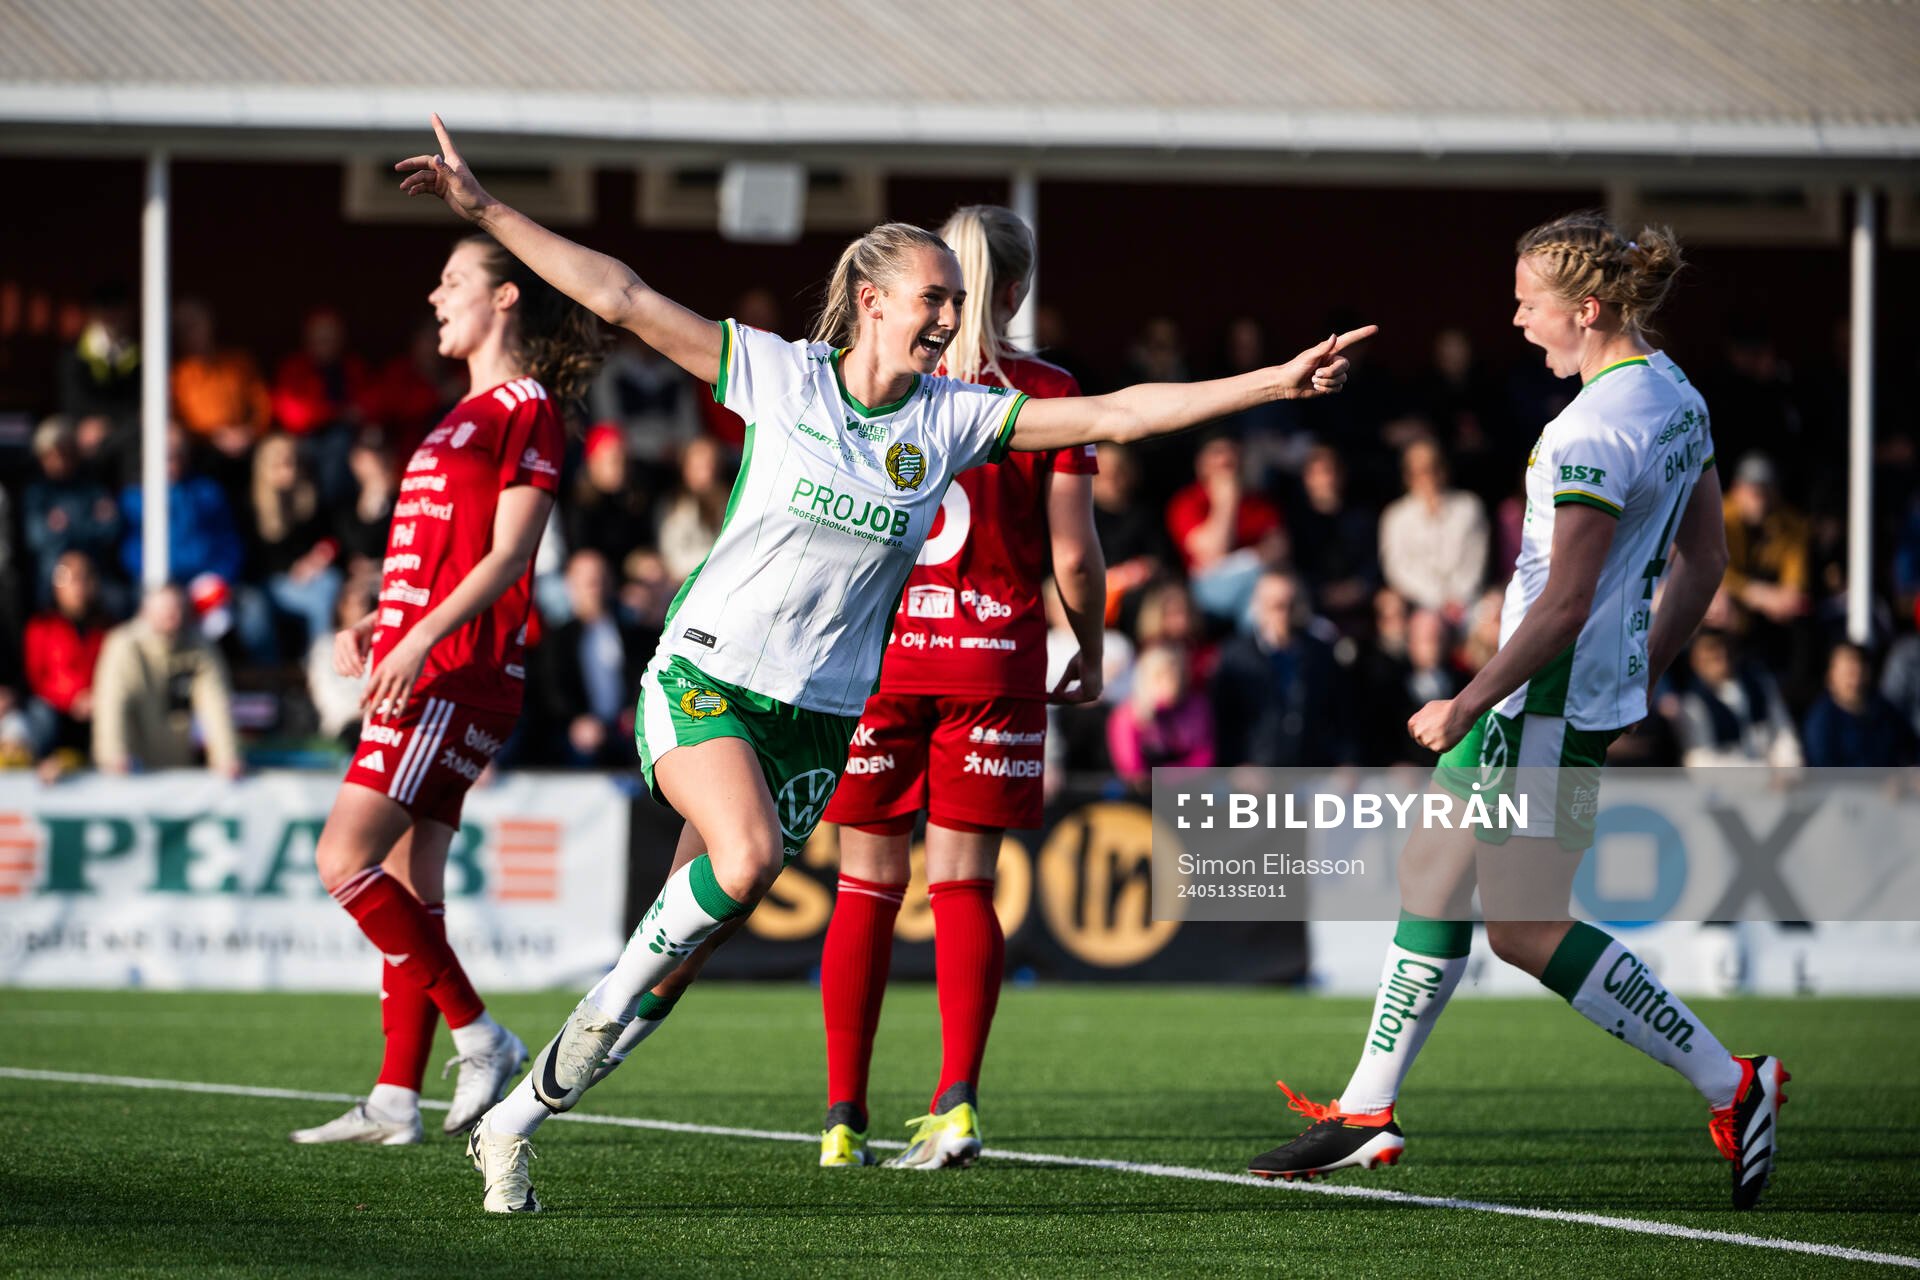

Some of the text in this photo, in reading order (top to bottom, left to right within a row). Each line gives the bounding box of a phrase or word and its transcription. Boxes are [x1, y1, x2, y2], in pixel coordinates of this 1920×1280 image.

[797, 423, 834, 449] CRAFT
[857, 430, 886, 443] SPORT
[858, 423, 887, 436] INTER
[1560, 465, 1606, 484] BST
[791, 477, 910, 537] PROJOB
[788, 505, 903, 549] PROFESSIONAL WORKWEAR
